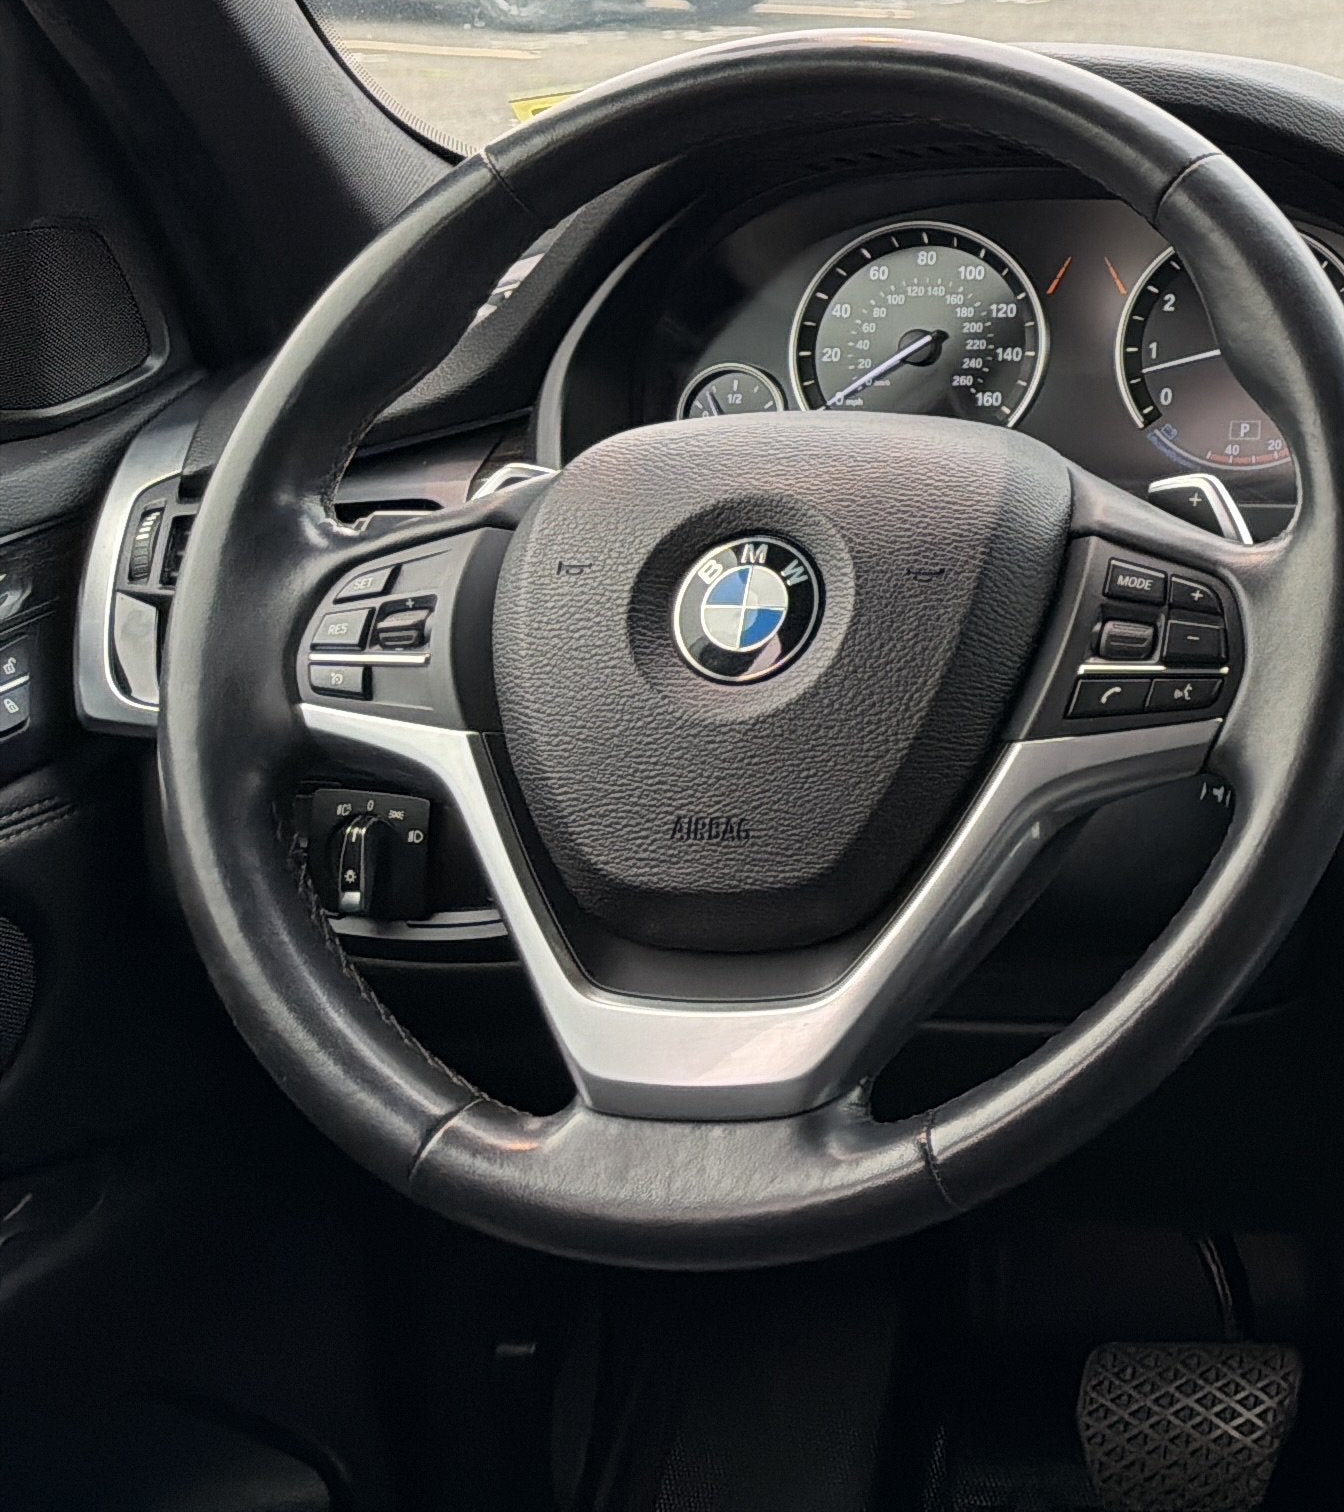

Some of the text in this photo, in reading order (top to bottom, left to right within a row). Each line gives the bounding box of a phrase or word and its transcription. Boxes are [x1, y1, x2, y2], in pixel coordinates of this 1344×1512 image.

[917, 251, 936, 265] 80
[870, 266, 889, 280] 60
[958, 266, 985, 280] 100
[907, 286, 925, 296] 120
[927, 286, 945, 296] 140
[887, 295, 905, 304] 100
[945, 295, 963, 304] 160
[1162, 294, 1175, 311] 2
[832, 304, 851, 319] 40
[873, 308, 887, 318] 80
[956, 308, 975, 317] 180
[990, 303, 1017, 318] 120
[862, 323, 876, 332] 60
[962, 323, 983, 332] 200
[856, 340, 870, 350] 40
[965, 340, 986, 350] 220
[1149, 342, 1157, 359] 1
[822, 348, 840, 362] 20
[996, 347, 1022, 362] 140
[858, 359, 871, 369] 20
[962, 359, 982, 369] 240
[952, 376, 973, 386] 260
[728, 393, 742, 404] 1/2
[845, 397, 864, 407] mph
[975, 392, 1001, 406] 160
[1160, 388, 1172, 405] 0
[1240, 423, 1250, 437] P
[1225, 445, 1240, 455] 40
[1268, 440, 1282, 451] 20
[697, 543, 808, 586] BMW
[353, 577, 373, 590] SET
[1117, 574, 1153, 591] MODE
[327, 623, 348, 635] RES
[670, 816, 751, 841] AIRBAG
